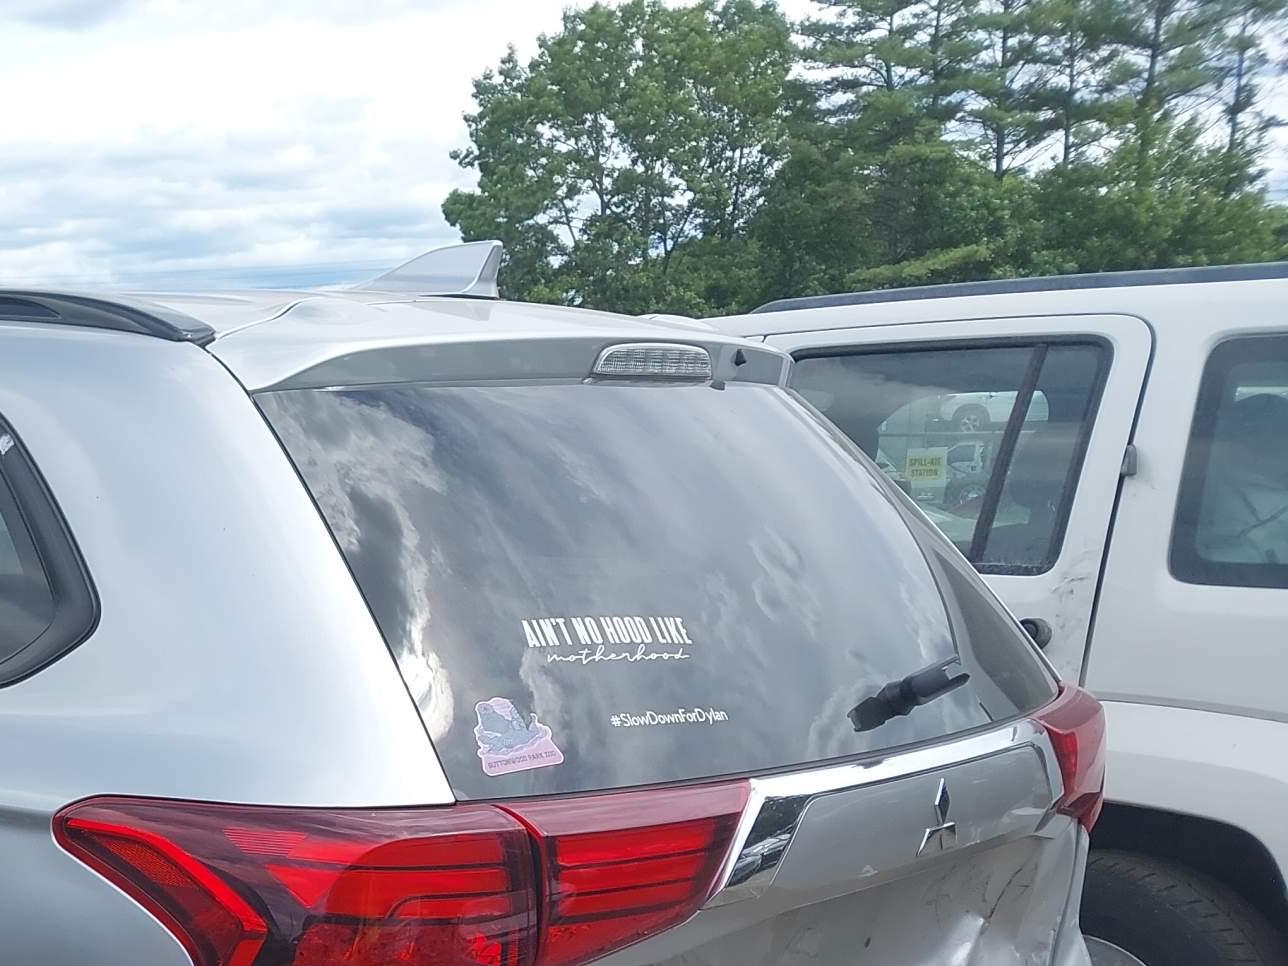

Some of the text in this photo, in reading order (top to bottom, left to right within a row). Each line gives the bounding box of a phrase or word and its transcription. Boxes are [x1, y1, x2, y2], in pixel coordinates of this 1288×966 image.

[521, 616, 693, 648] AIN'T NO HOOD LIKE
[547, 644, 690, 665] motherhood
[610, 708, 729, 727] #SlowDownForDylan
